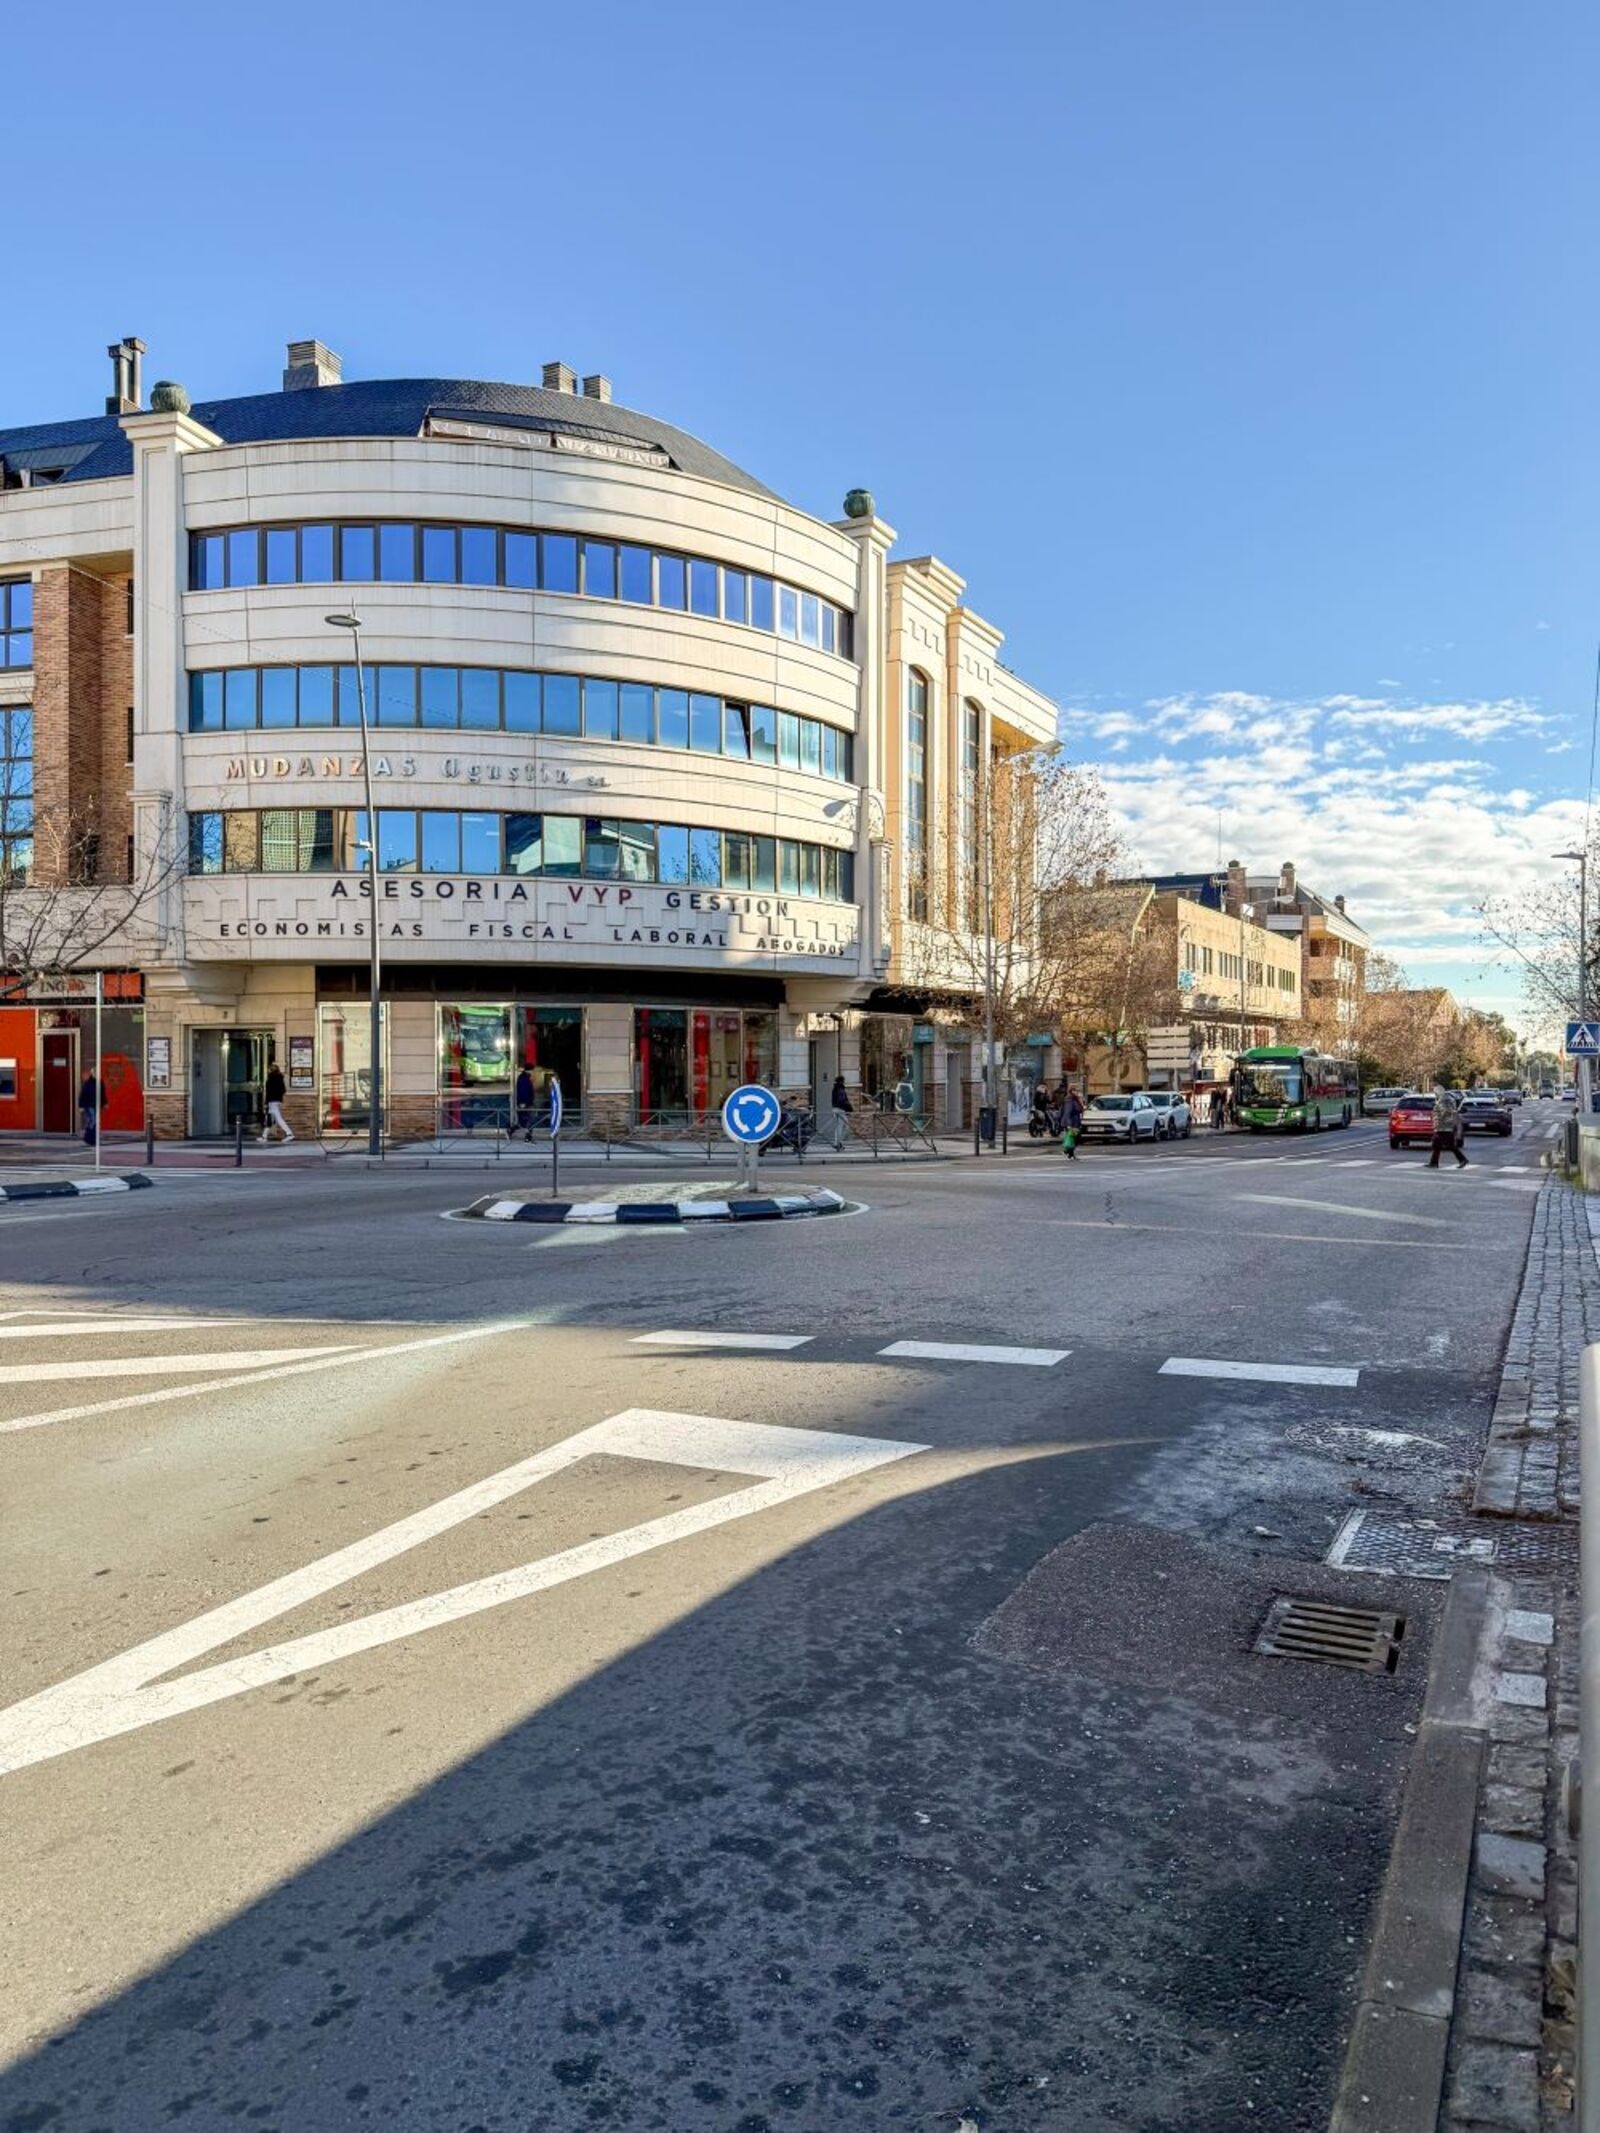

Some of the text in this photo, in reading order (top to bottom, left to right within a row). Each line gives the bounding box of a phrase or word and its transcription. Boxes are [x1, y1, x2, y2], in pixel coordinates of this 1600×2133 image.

[227, 756, 416, 779] MUDANZAS
[331, 880, 788, 916] ASESORIA VYP GESTION
[220, 922, 845, 957] ECONOMISAS FISCAL LABORAL ABOGADOS
[41, 981, 64, 993] ING
